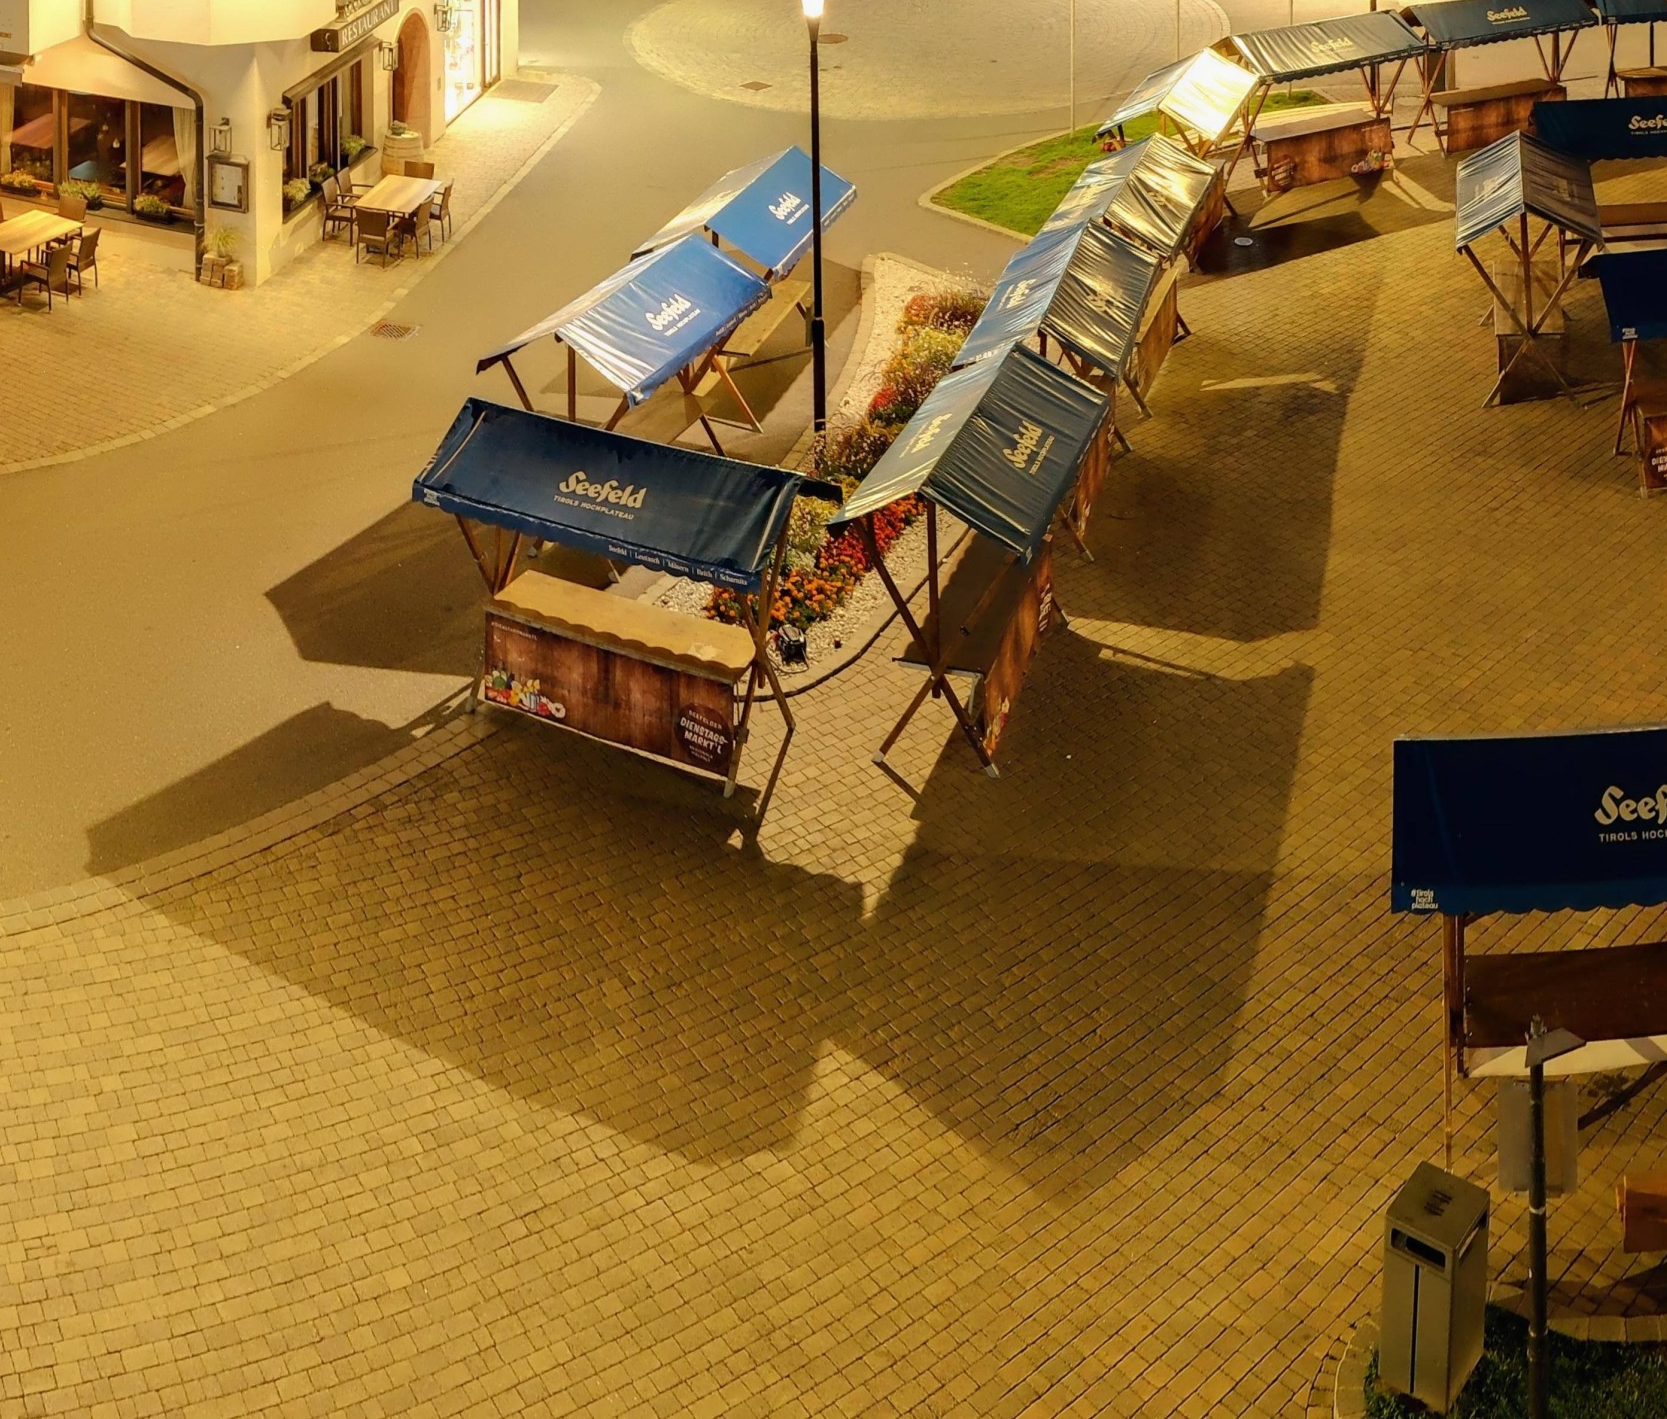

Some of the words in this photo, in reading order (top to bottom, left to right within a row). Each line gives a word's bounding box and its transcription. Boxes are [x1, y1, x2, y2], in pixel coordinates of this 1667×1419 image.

[1486, 6, 1528, 22] Seefeld
[1310, 37, 1353, 53] Seefeld
[768, 191, 801, 220] Seefeld
[645, 293, 692, 331] Seefeld
[1003, 420, 1044, 469] Seefeld
[559, 471, 647, 509] Seefeld
[553, 494, 579, 508] TIROLS
[580, 501, 634, 520] HOCHPLATEAU
[680, 717, 729, 744] DIENSTAGS-
[684, 731, 722, 755] MARKT'L
[1598, 830, 1638, 843] TIROLS
